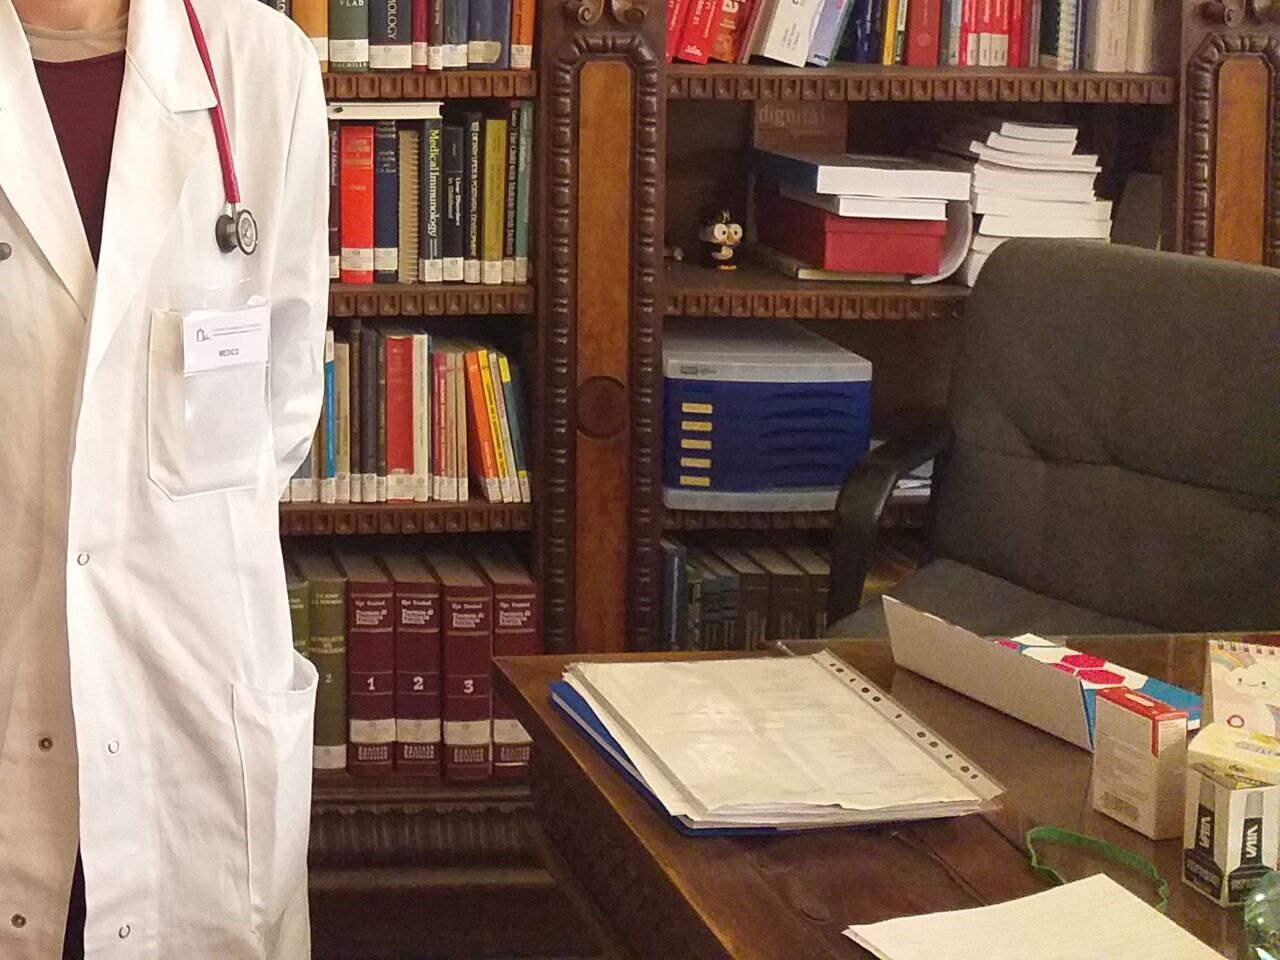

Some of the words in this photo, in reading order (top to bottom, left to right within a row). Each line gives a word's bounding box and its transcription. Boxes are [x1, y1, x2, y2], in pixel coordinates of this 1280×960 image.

[339, 0, 365, 7] VLAD
[509, 132, 518, 144] The
[428, 129, 440, 171] Medical
[508, 145, 517, 164] Child
[508, 165, 516, 181] with
[454, 177, 462, 194] Liver
[427, 171, 440, 237] Immunology
[447, 185, 455, 219] Childhood
[507, 182, 516, 210] Multiple
[454, 195, 462, 226] Disorders
[506, 210, 515, 228] Birth
[218, 348, 240, 357] MEDICO
[325, 673, 333, 683] 2
[366, 677, 376, 691] 1
[413, 676, 424, 691] 2
[463, 679, 474, 694] 3
